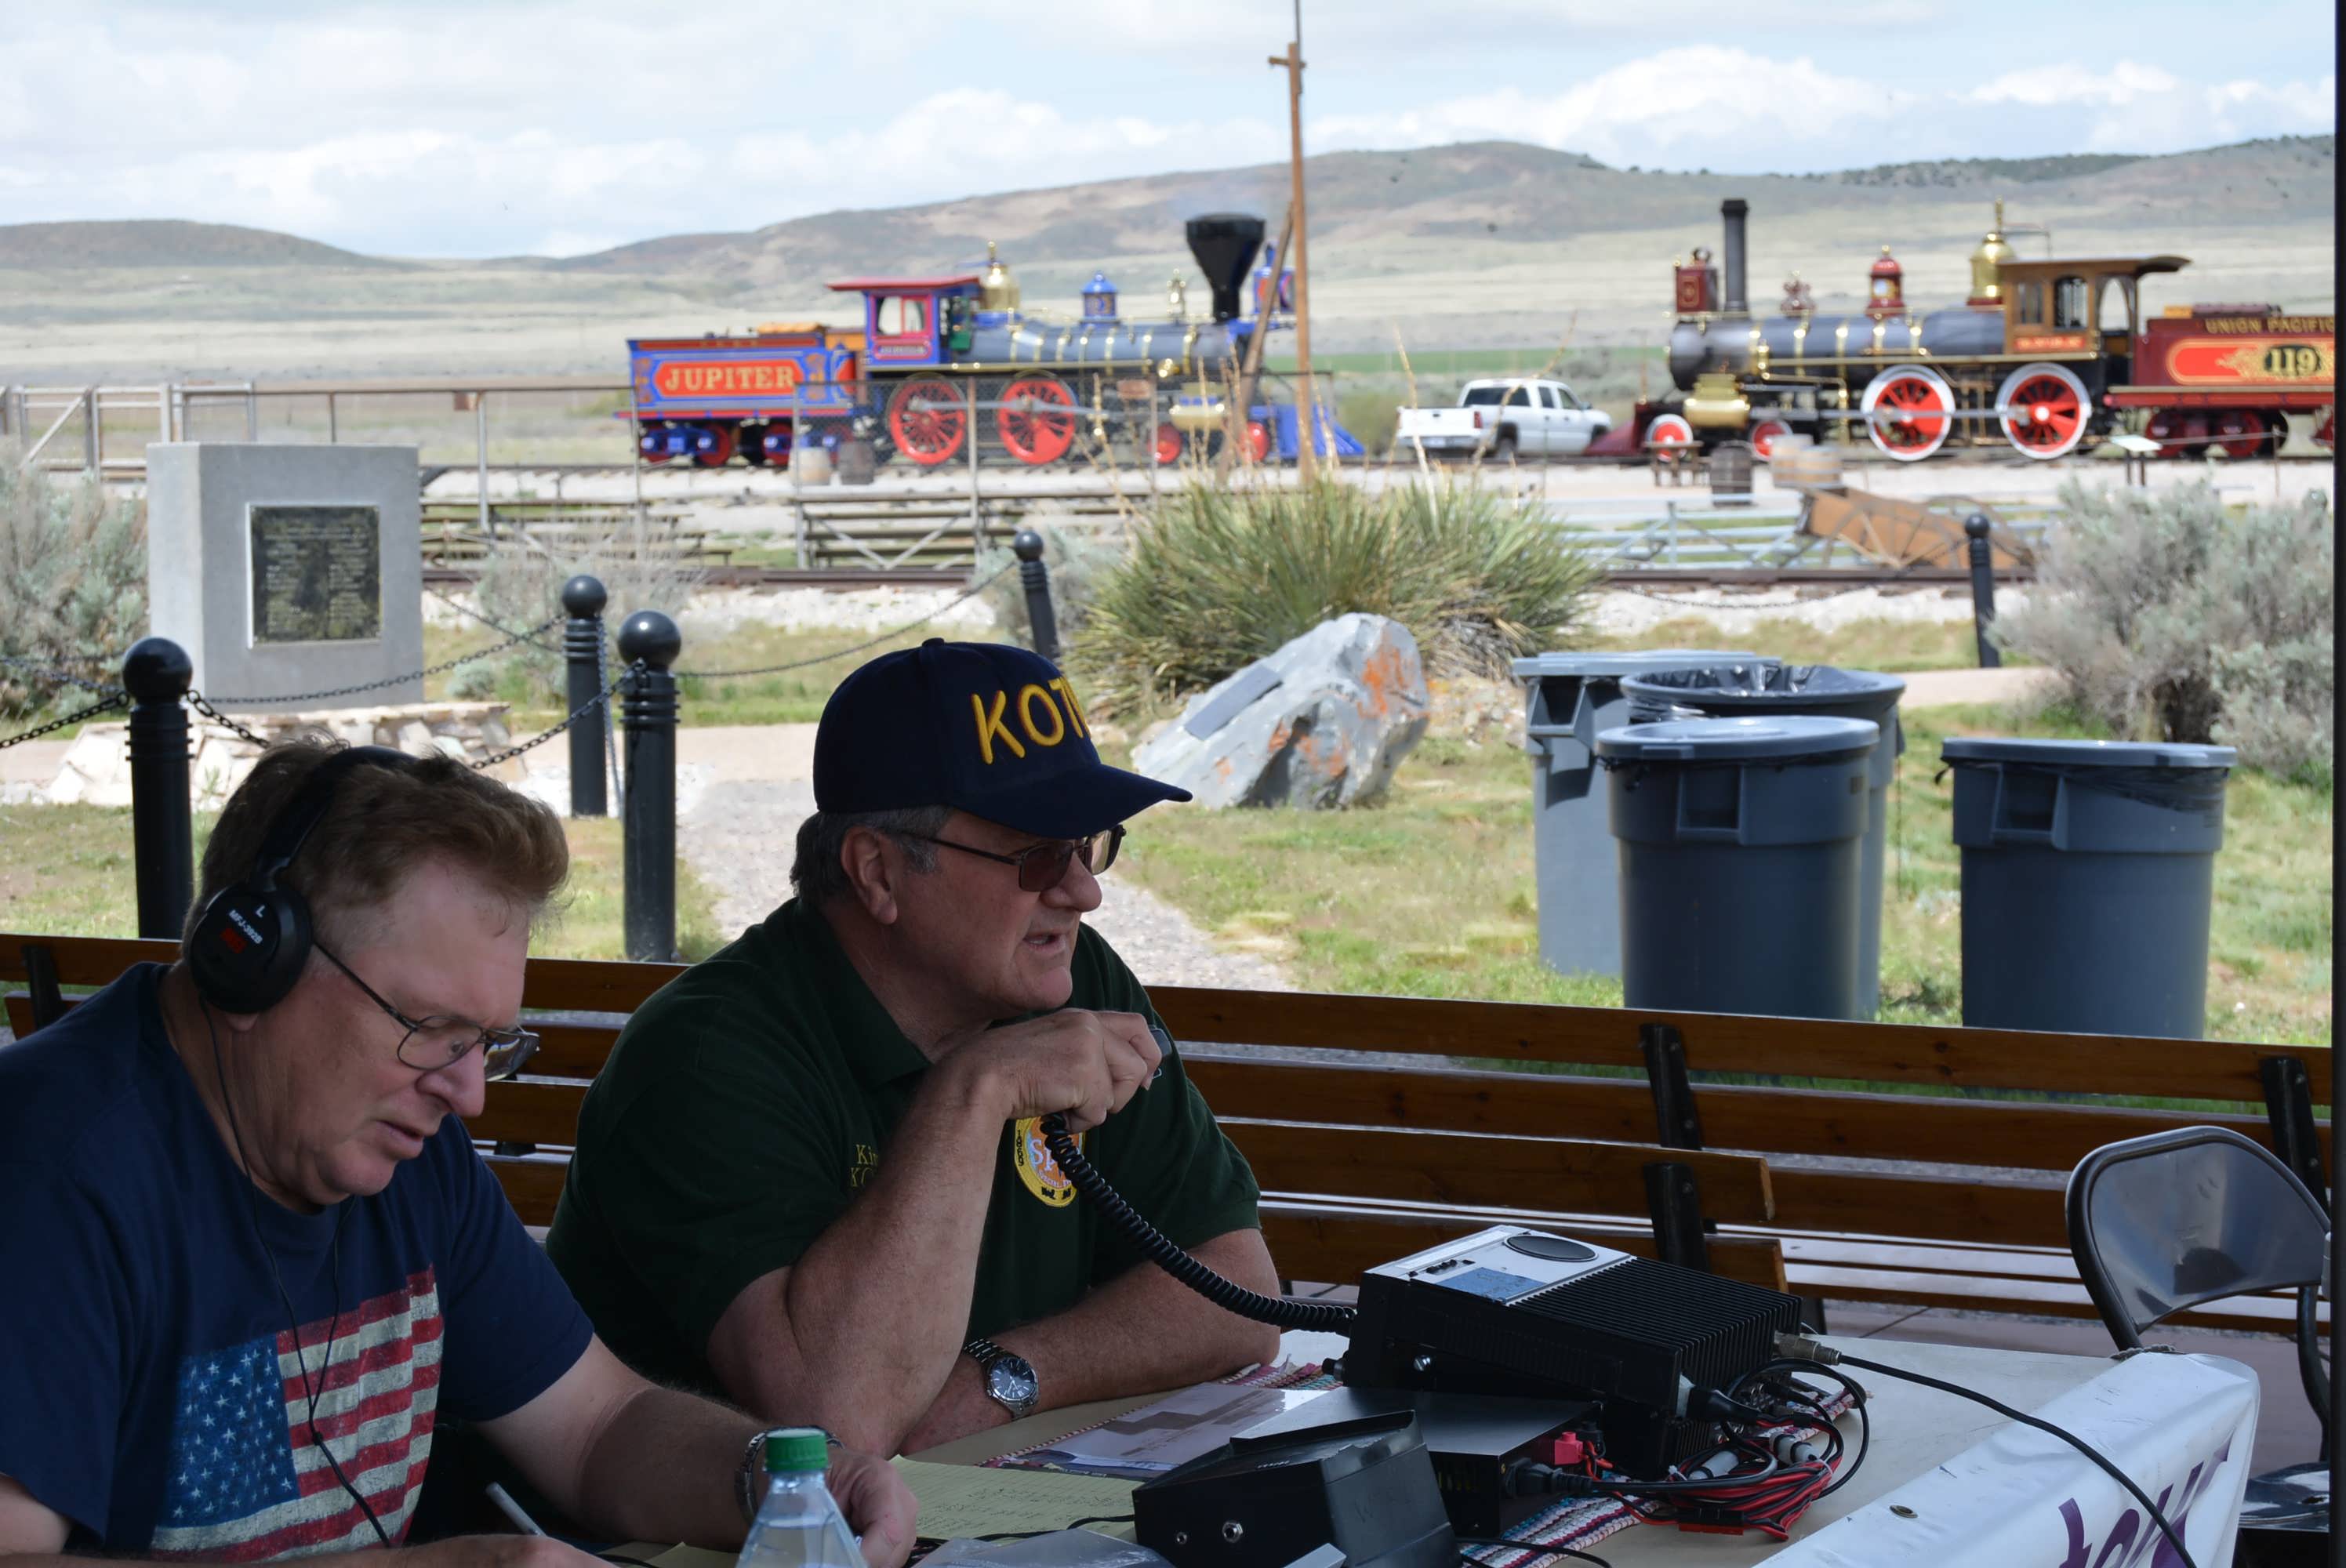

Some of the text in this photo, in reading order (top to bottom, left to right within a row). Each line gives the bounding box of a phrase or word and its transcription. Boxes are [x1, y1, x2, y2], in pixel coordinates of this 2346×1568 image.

[2204, 317, 2335, 335] UNION PACIFIC
[2270, 348, 2318, 377] 119
[665, 366, 795, 390] JUPITER
[971, 675, 1092, 765] KOT
[255, 905, 266, 918] L
